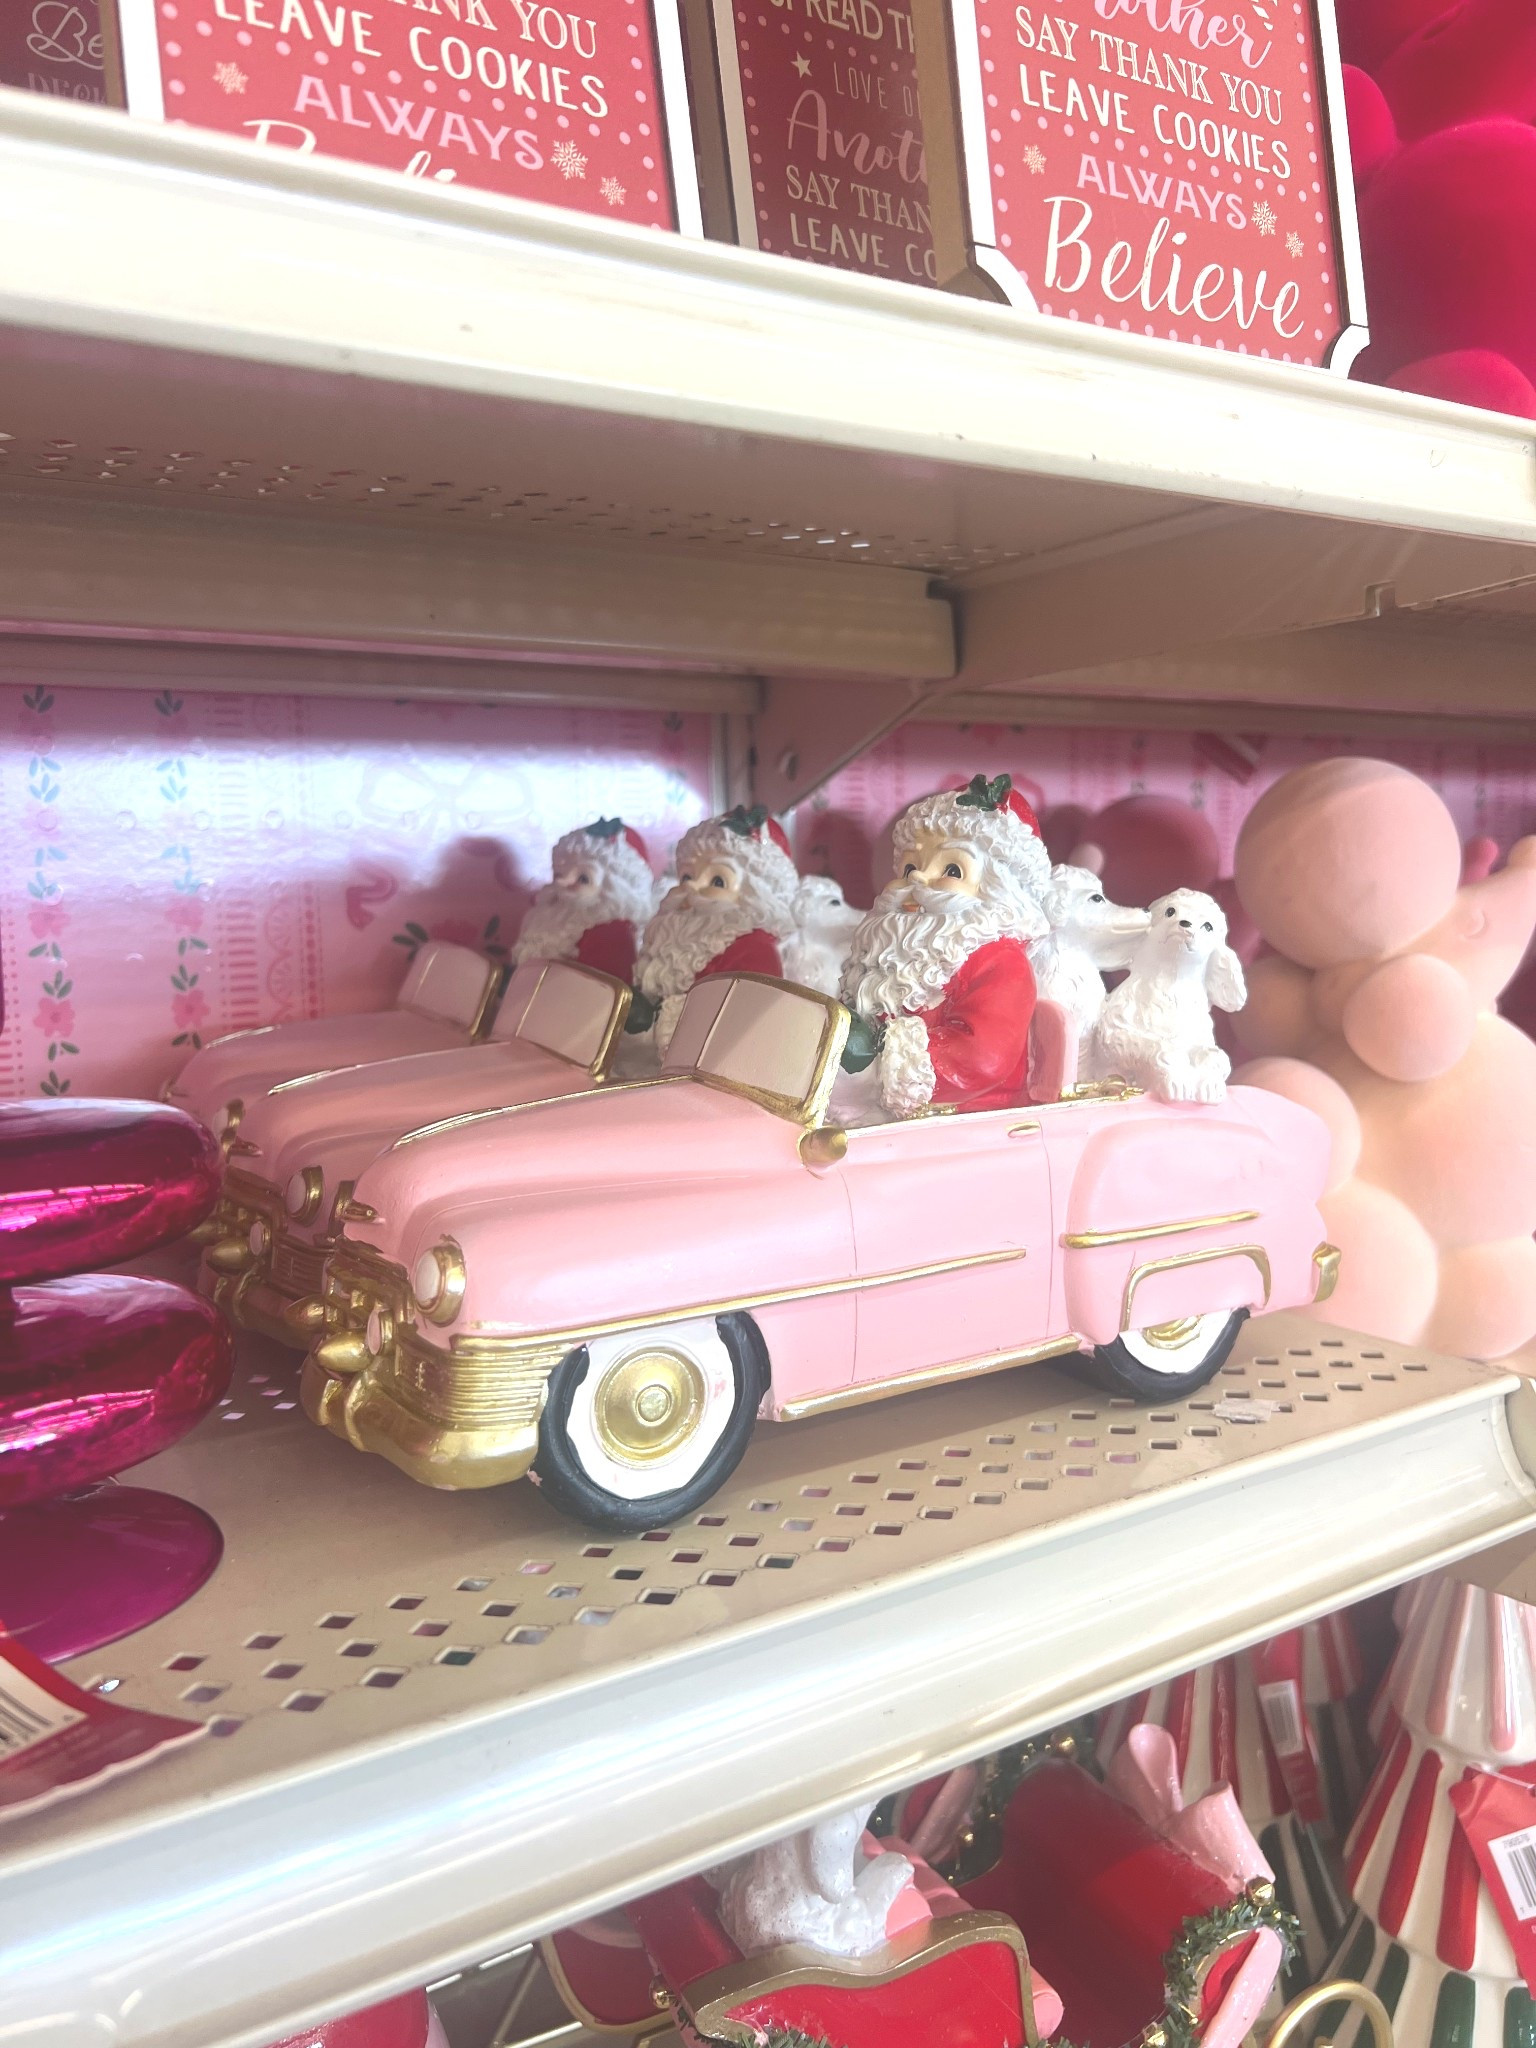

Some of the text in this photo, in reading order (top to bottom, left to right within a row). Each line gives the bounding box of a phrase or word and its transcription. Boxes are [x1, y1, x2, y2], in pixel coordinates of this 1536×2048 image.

[512, 0, 597, 58] YOU
[1015, 5, 1282, 125] SAY THANK YOU
[1055, 0, 1273, 69] other
[409, 26, 608, 117] COOKIES
[833, 61, 921, 120] LOVE O
[294, 74, 544, 170] ALWAYS
[786, 90, 928, 186] Anot
[1019, 63, 1291, 179] LEAVE COOKIES
[786, 164, 840, 210] SAY
[1076, 153, 1248, 230] ALWAYS
[790, 212, 890, 268] LEAVE
[1043, 196, 1305, 339] Believe
